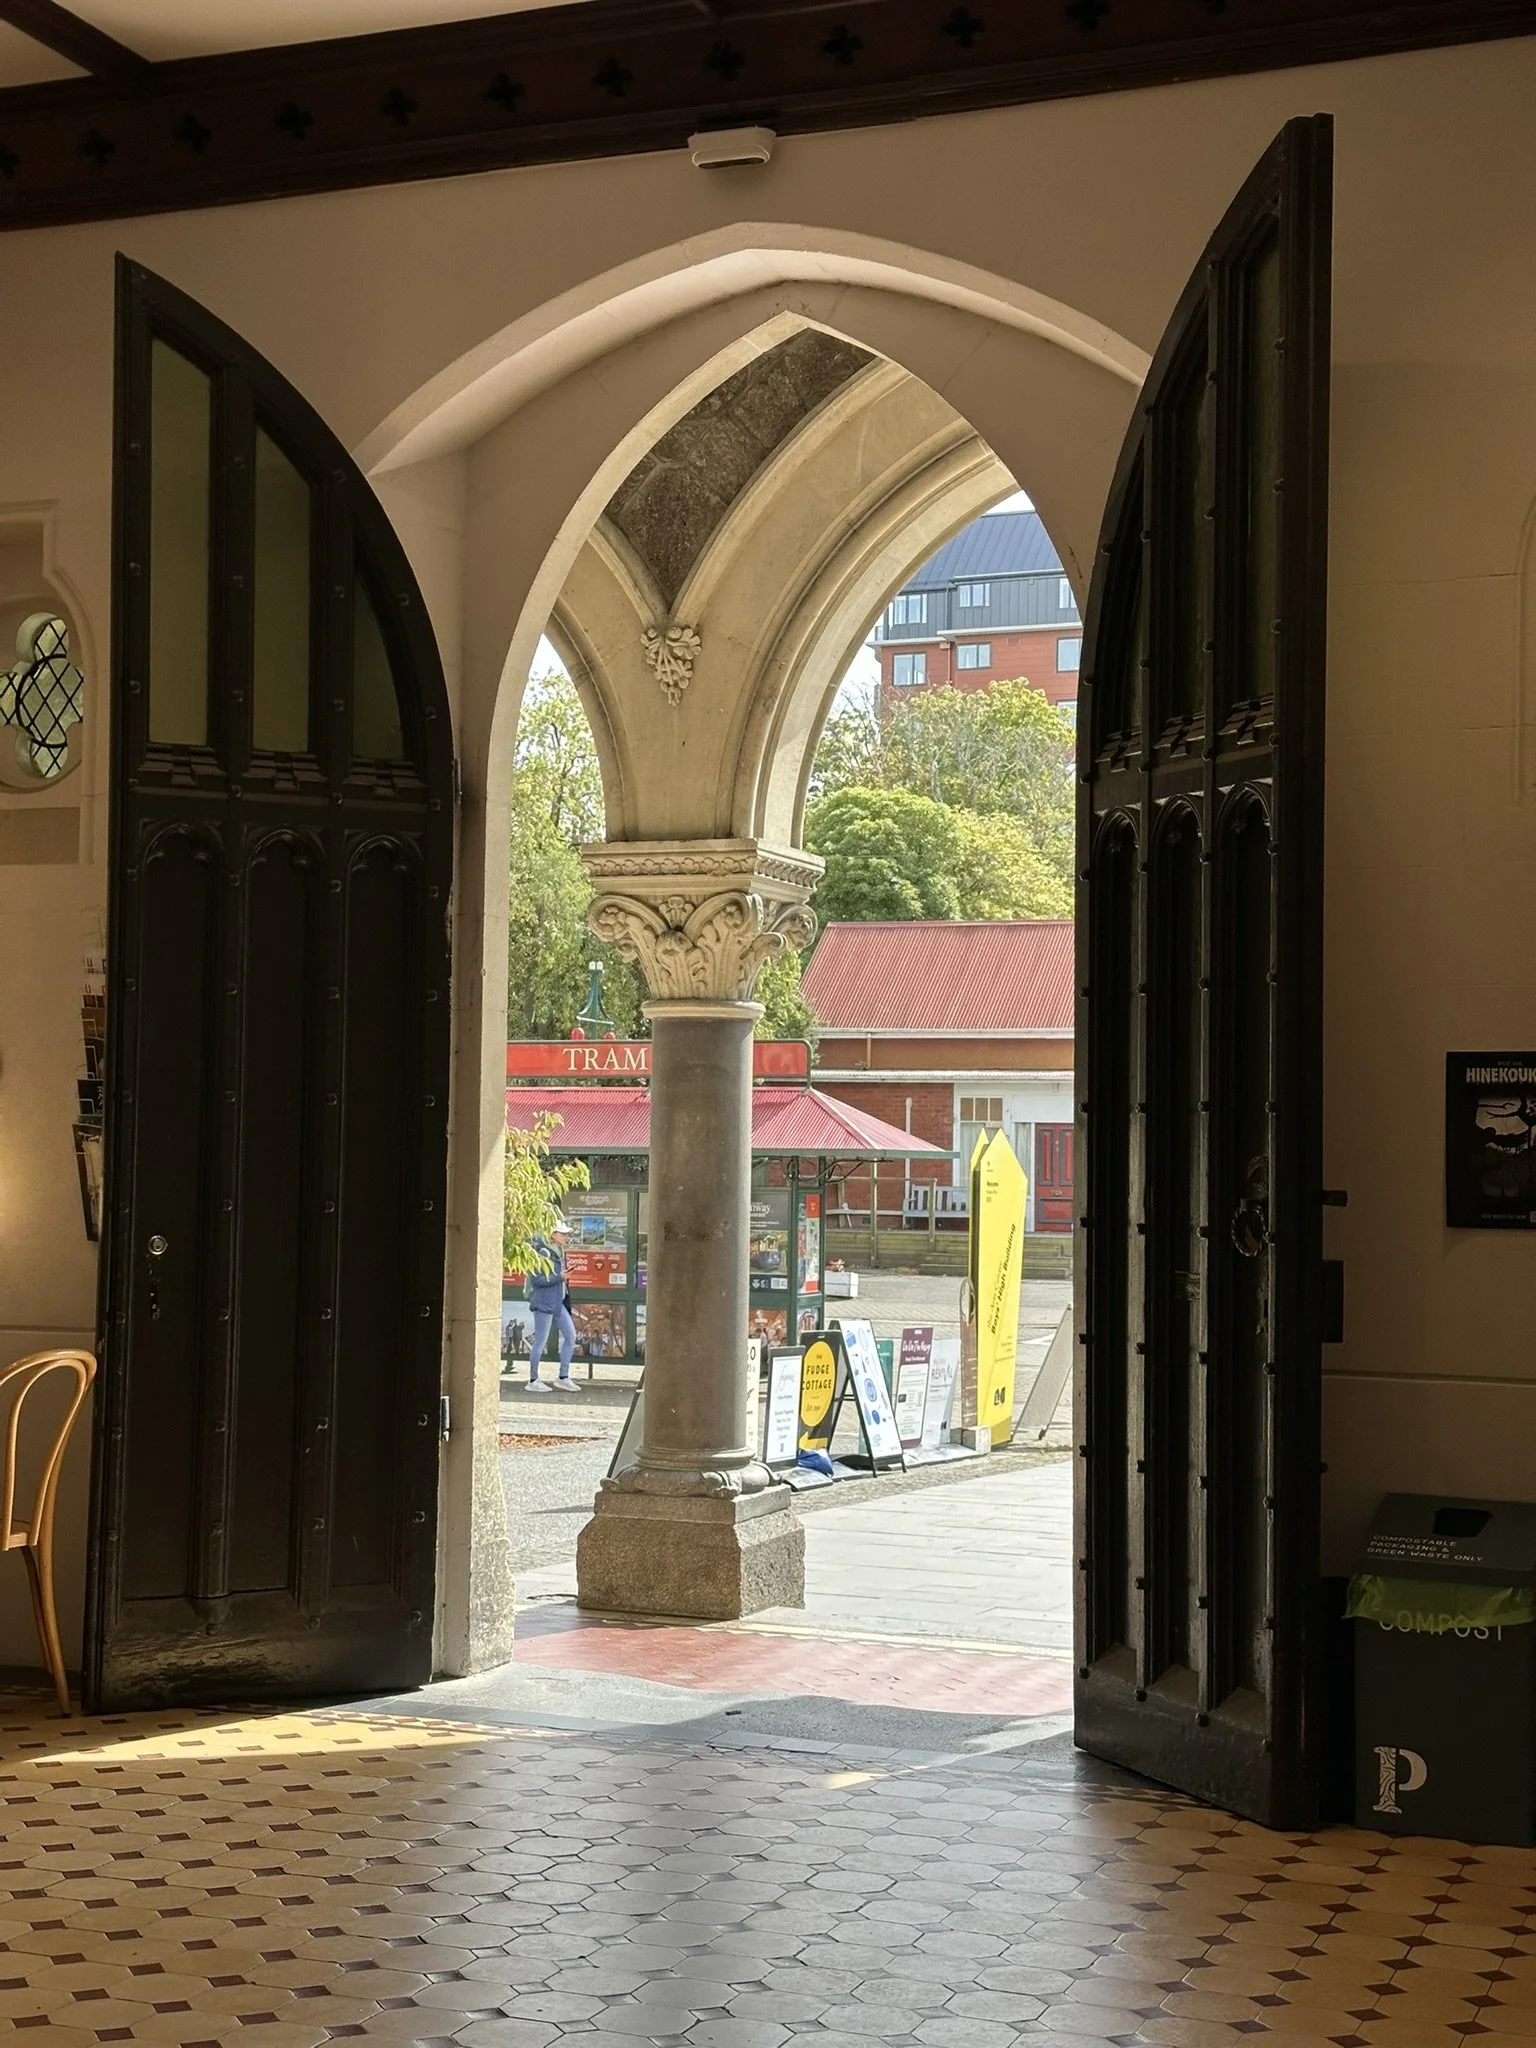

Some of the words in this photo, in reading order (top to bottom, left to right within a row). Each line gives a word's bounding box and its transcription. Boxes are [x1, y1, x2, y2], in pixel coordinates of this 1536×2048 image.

[562, 1047, 649, 1071] TRAM
[997, 1274, 1006, 1301] High
[1003, 1223, 1016, 1271] Building
[806, 1364, 830, 1375] FUDGE
[801, 1379, 832, 1391] COTTAGE
[1369, 1540, 1437, 1551] PACKAGING
[1373, 1534, 1457, 1547] COMPOSTABLE
[1366, 1547, 1405, 1555] GREEN
[1410, 1551, 1451, 1559] WASTE
[1454, 1554, 1483, 1562] ONLY
